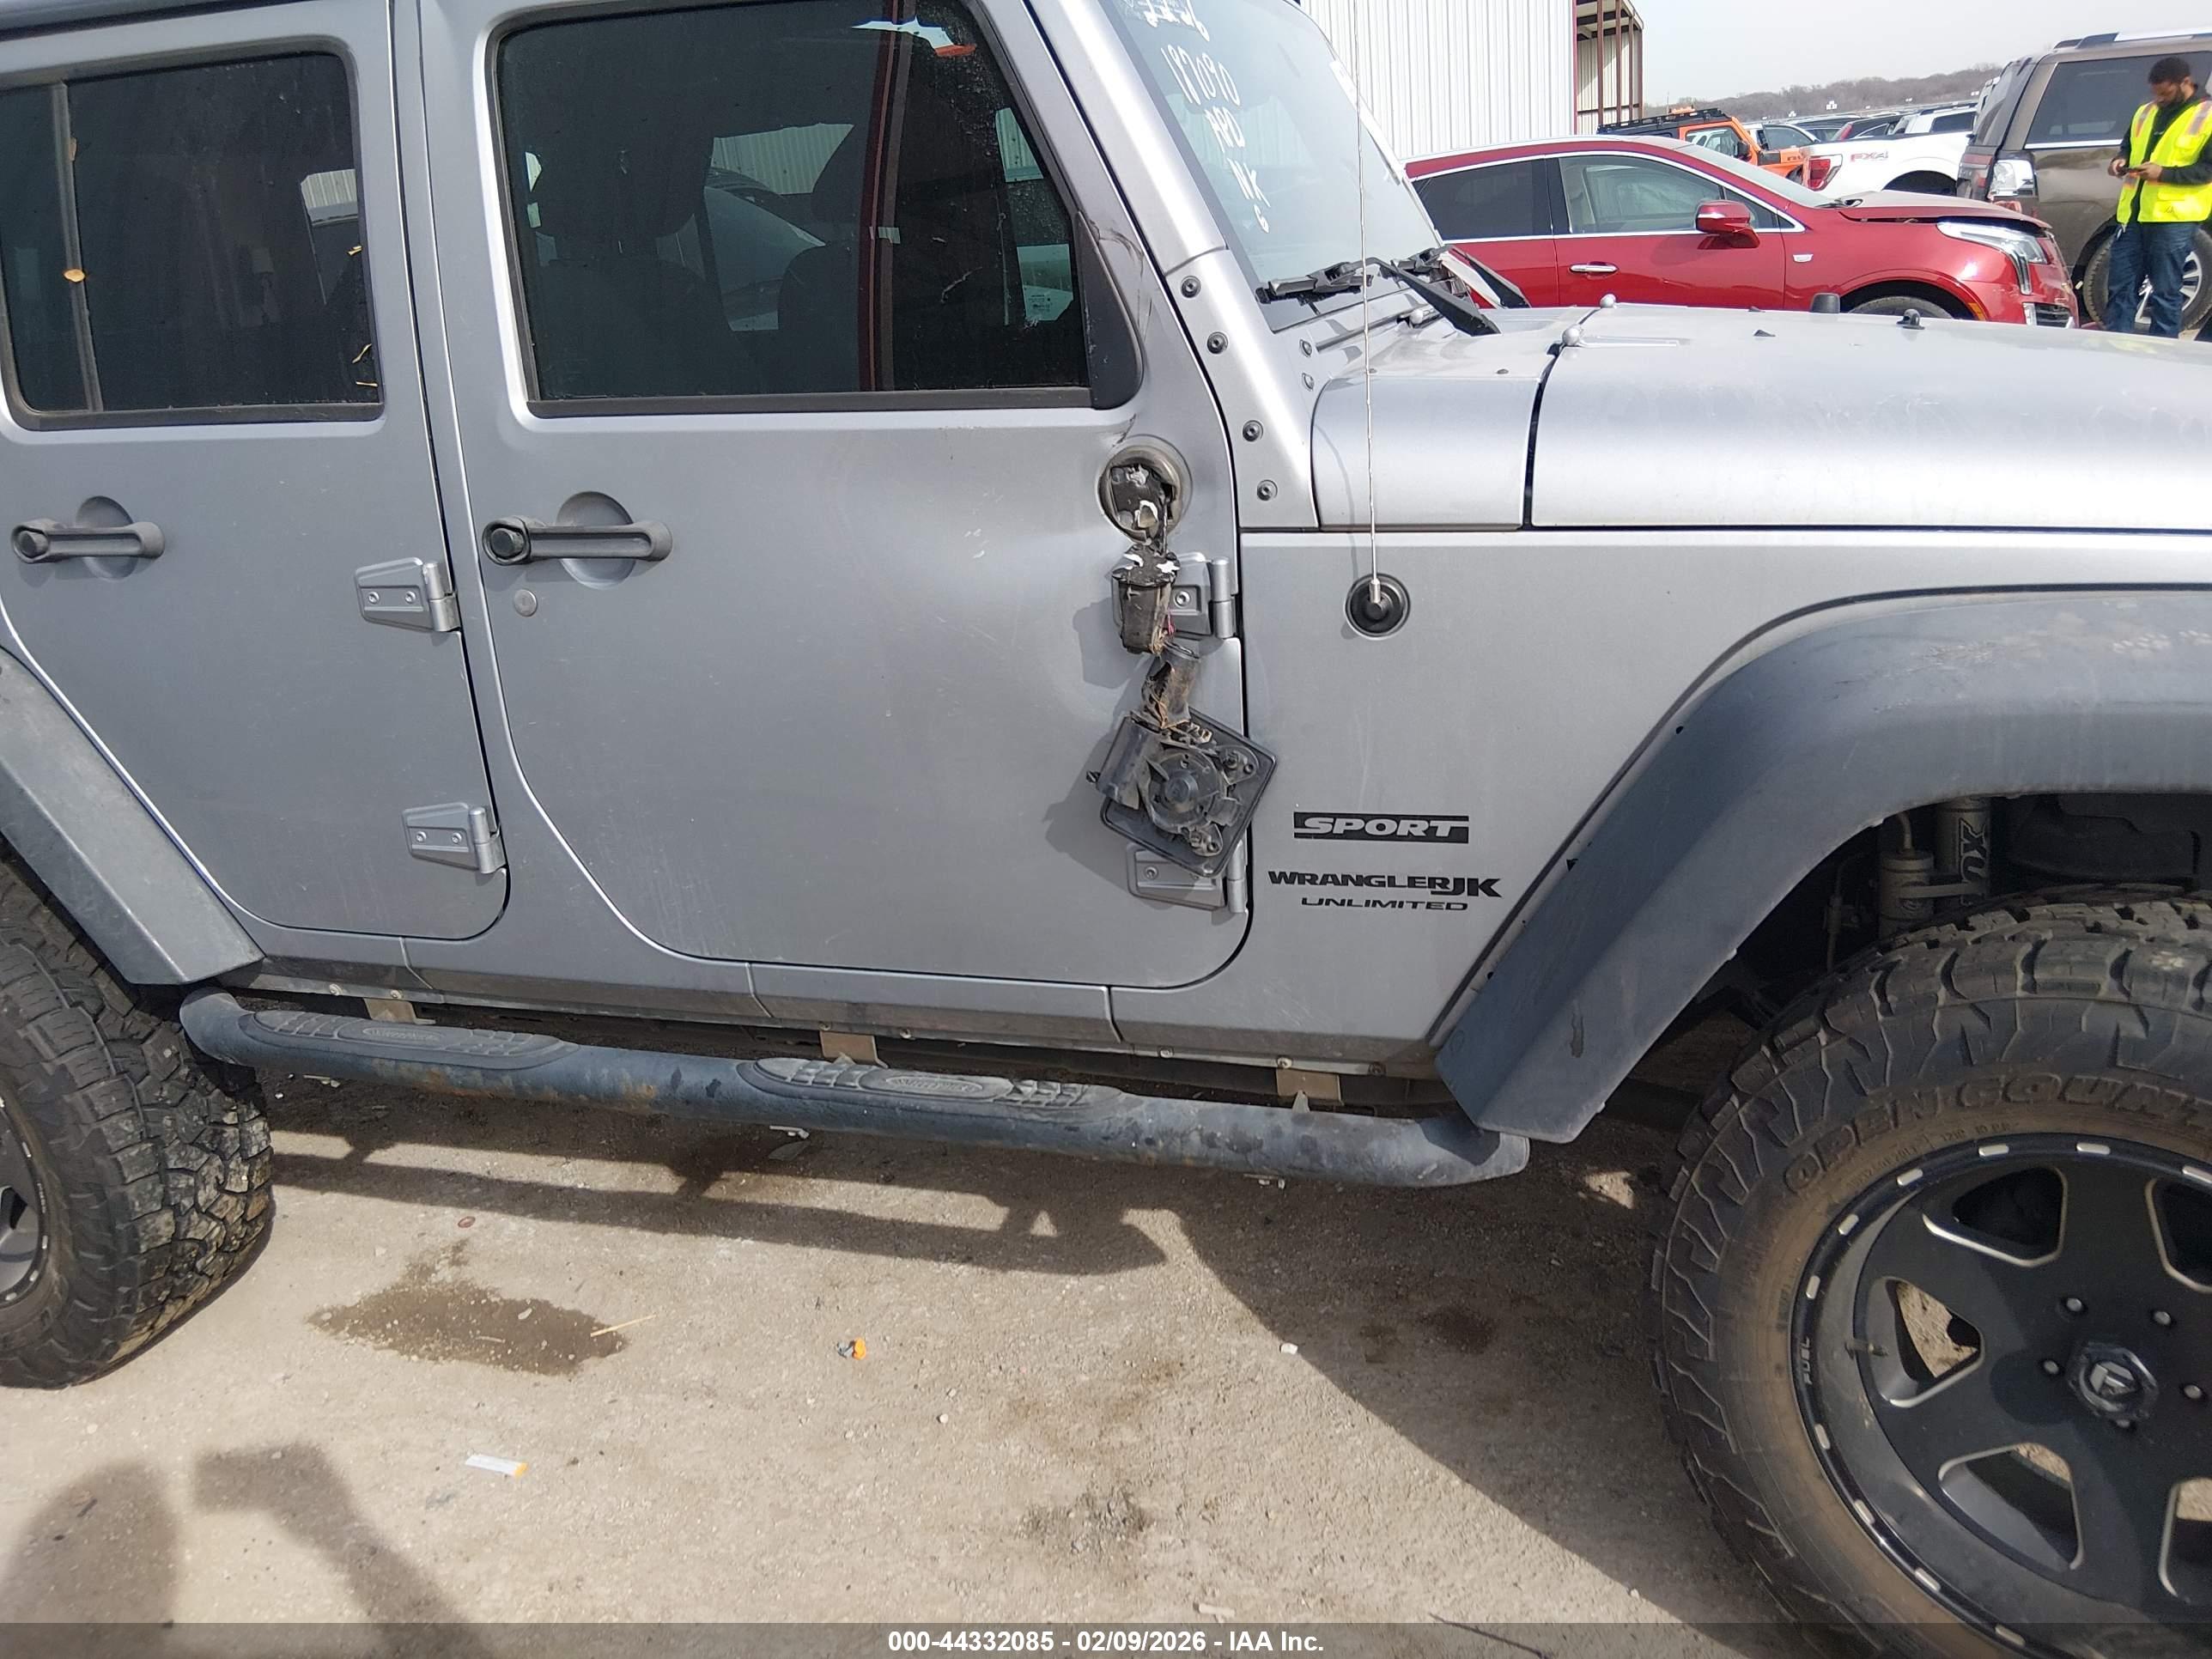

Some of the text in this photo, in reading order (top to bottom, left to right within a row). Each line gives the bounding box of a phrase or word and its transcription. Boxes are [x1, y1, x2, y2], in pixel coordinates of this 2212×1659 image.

[1294, 816, 1468, 838] SPORT
[1301, 897, 1468, 911] UNLIMITED
[1784, 1085, 1941, 1194] OPEN
[1800, 1336, 1813, 1385] FUEL
